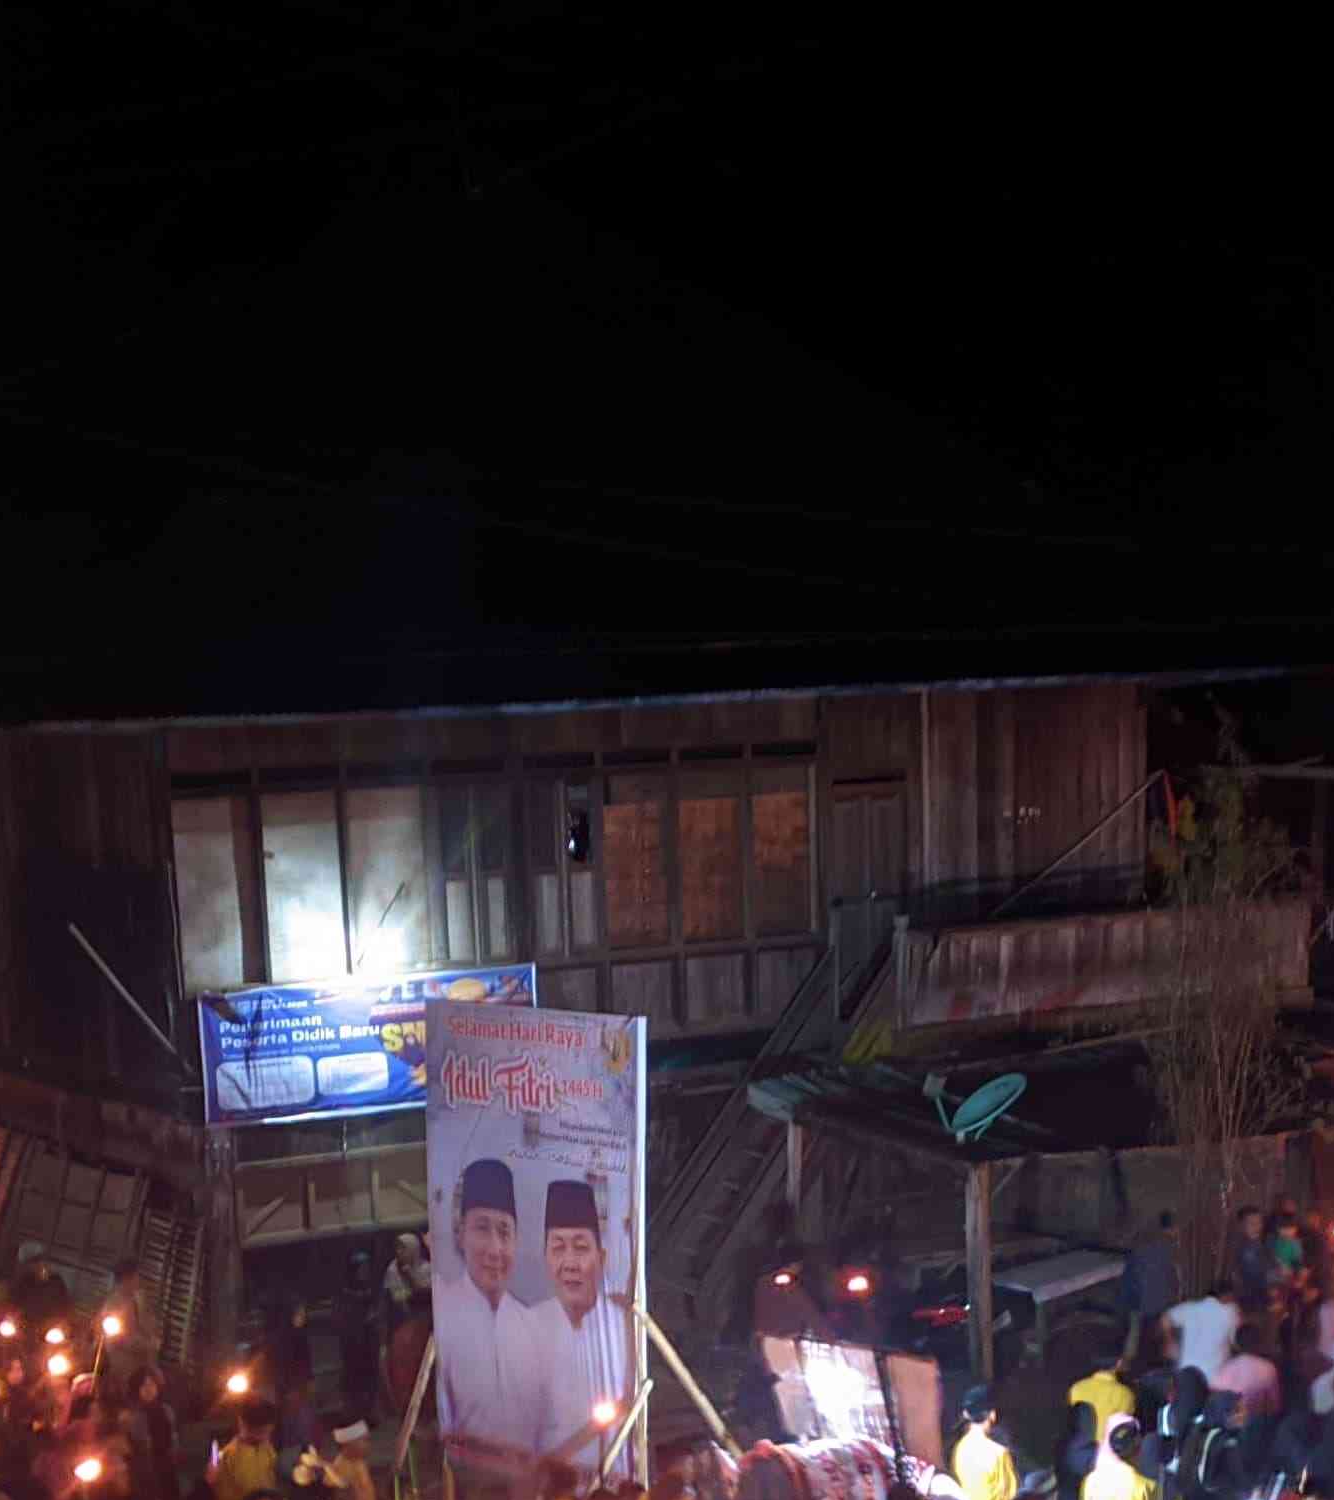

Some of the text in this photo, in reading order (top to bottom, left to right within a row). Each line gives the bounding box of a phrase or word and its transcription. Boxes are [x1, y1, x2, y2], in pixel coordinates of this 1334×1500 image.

[291, 1027, 335, 1043] Didik
[339, 1023, 380, 1041] Baru
[449, 1016, 583, 1048] Selamat Hari Raya
[442, 1051, 492, 1110] Idul
[494, 1052, 557, 1115] Fitri
